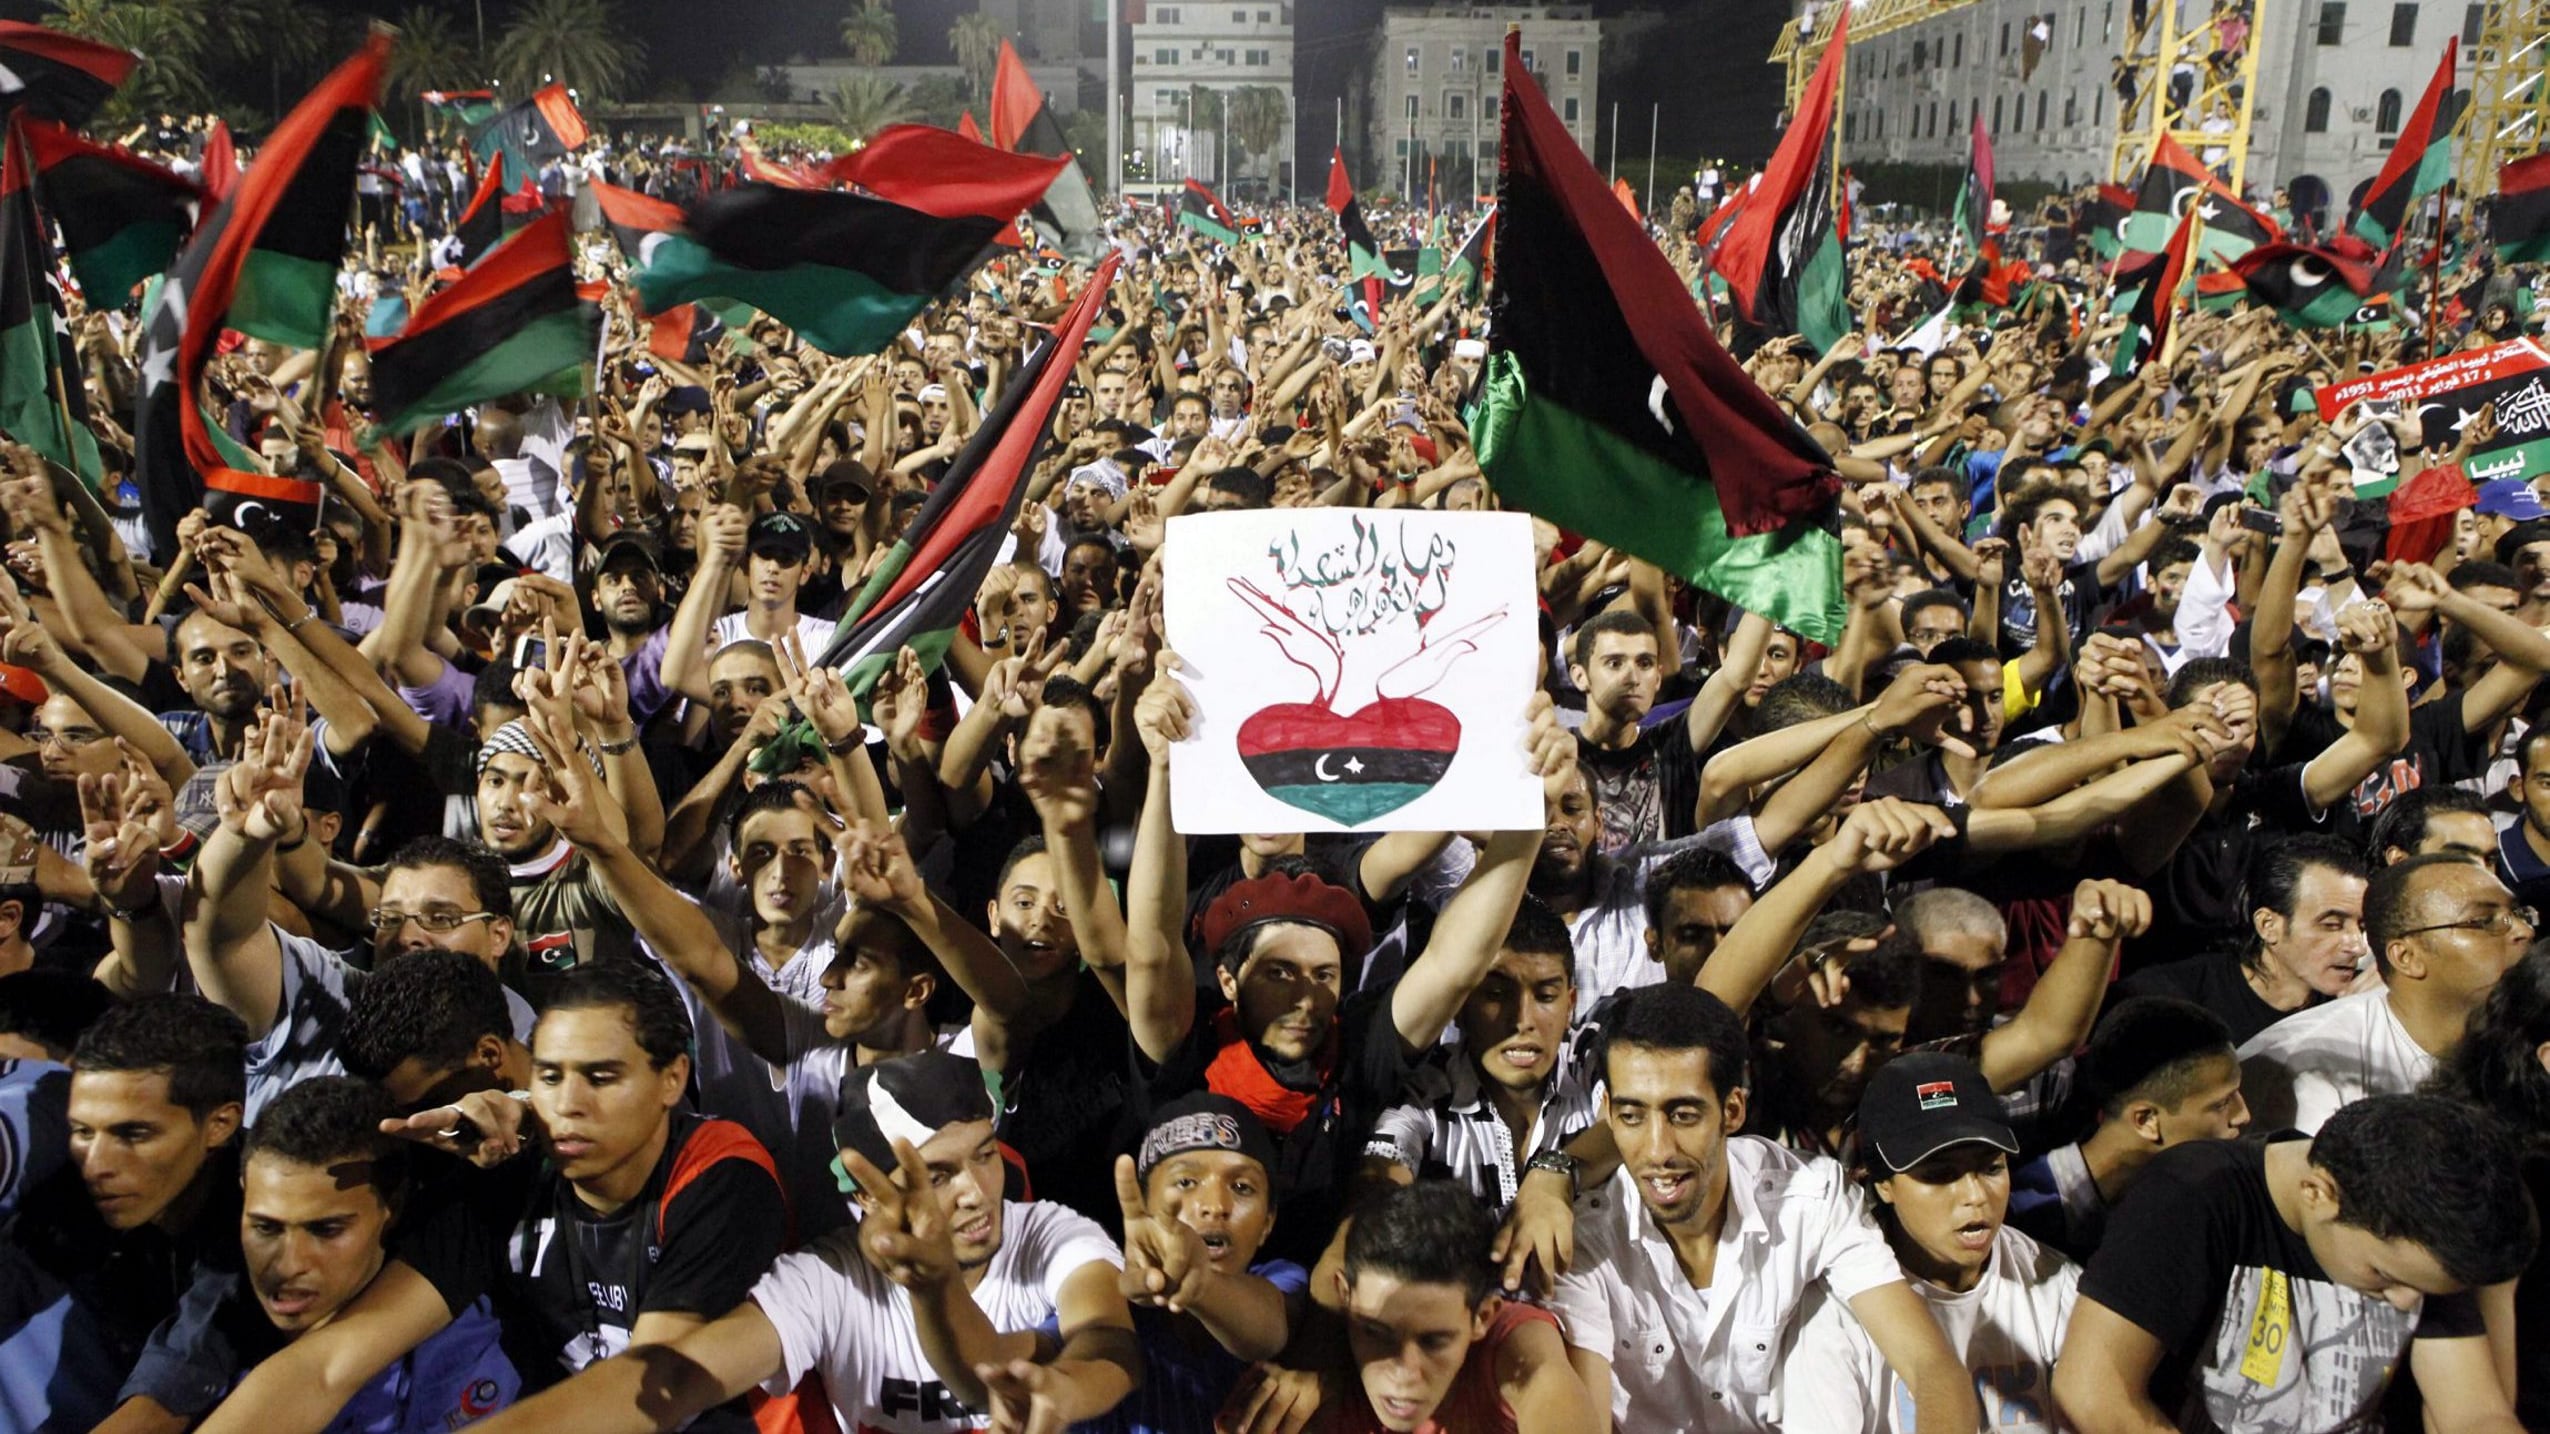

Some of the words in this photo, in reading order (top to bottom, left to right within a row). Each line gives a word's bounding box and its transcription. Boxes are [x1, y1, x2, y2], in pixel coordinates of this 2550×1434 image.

[2461, 369, 2480, 384] 17
[2469, 449, 2526, 480] ليبيا
[2252, 1314, 2283, 1355] 30
